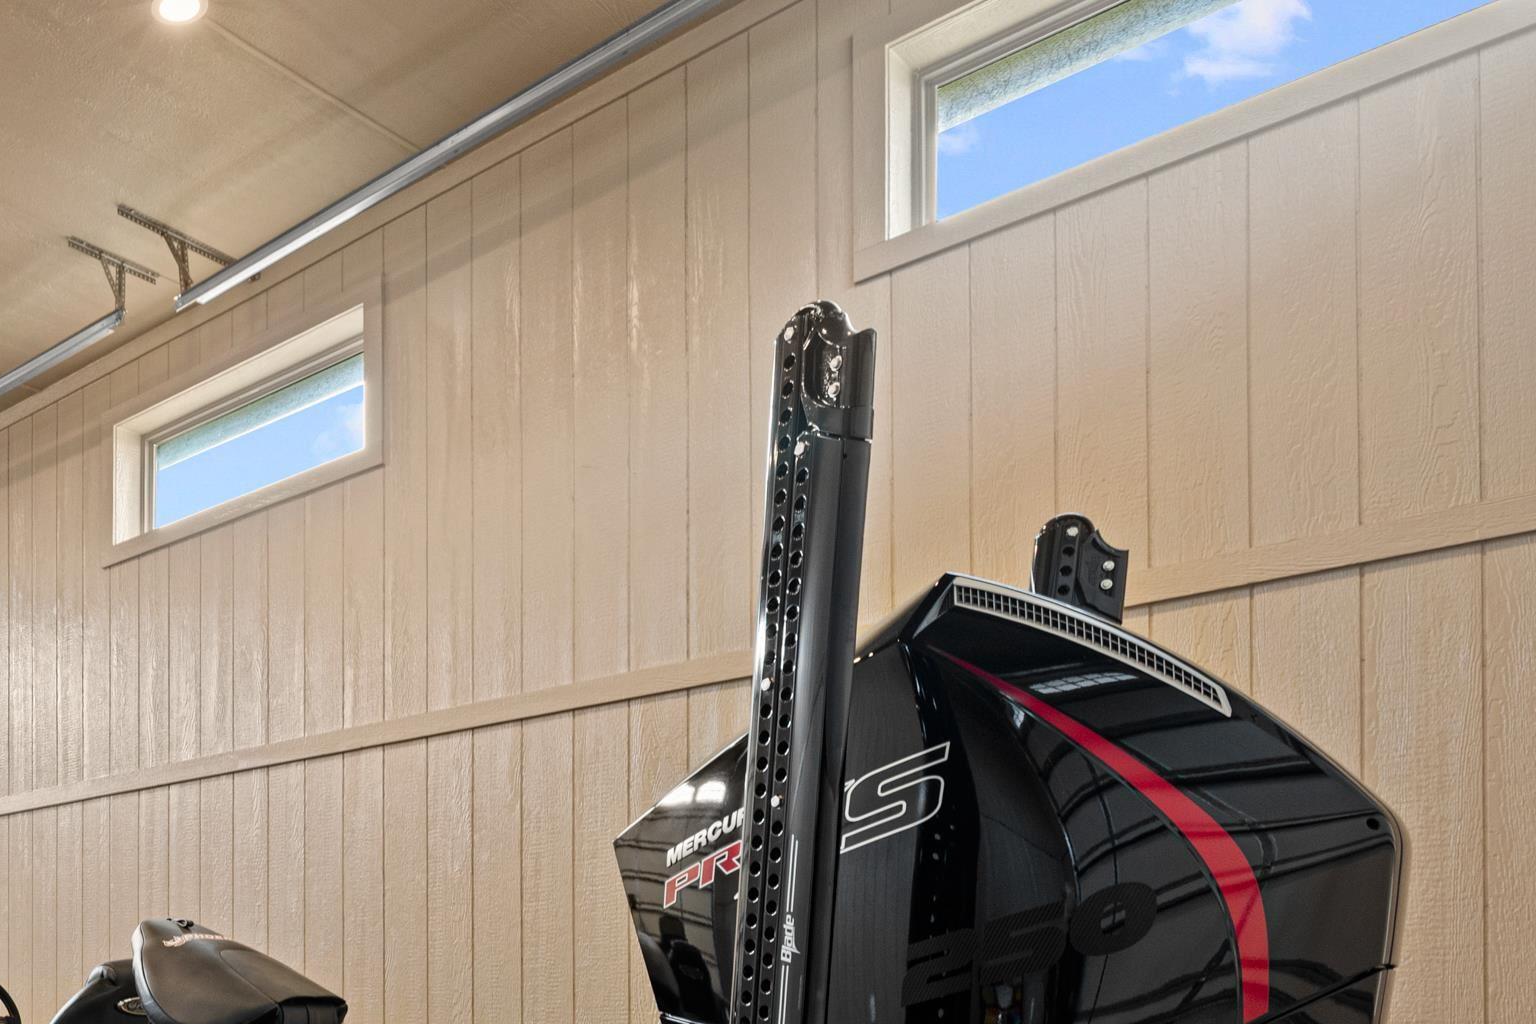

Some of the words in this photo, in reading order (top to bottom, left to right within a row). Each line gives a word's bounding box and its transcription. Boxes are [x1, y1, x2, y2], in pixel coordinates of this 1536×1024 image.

[663, 839, 743, 910] PR
[840, 741, 951, 854] S
[780, 914, 801, 963] Blade
